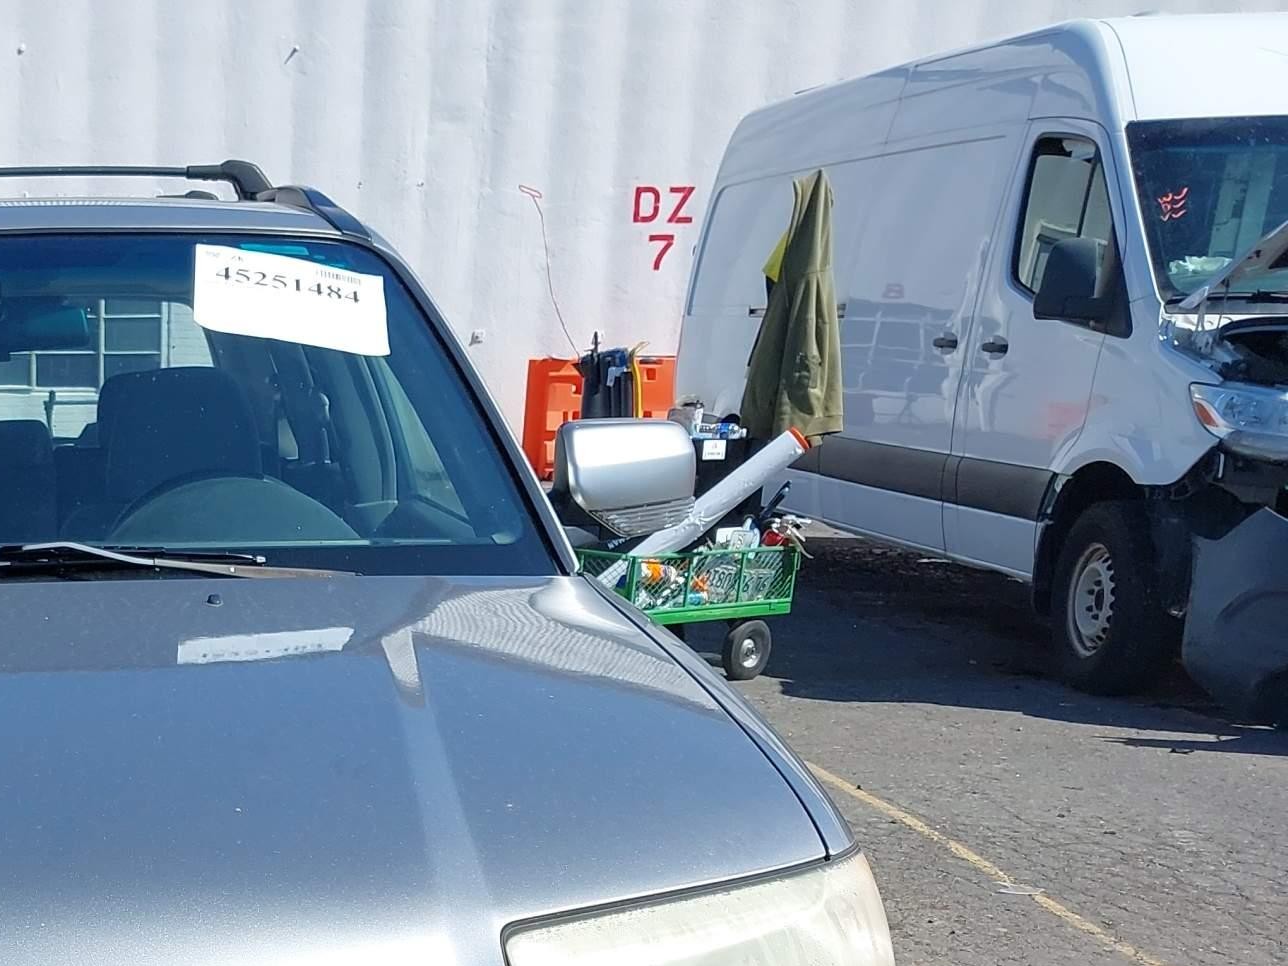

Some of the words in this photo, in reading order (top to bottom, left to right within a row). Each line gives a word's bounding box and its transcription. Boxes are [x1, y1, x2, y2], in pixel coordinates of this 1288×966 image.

[632, 186, 696, 223] DZ
[648, 234, 675, 271] 7
[215, 266, 361, 303] 45251484
